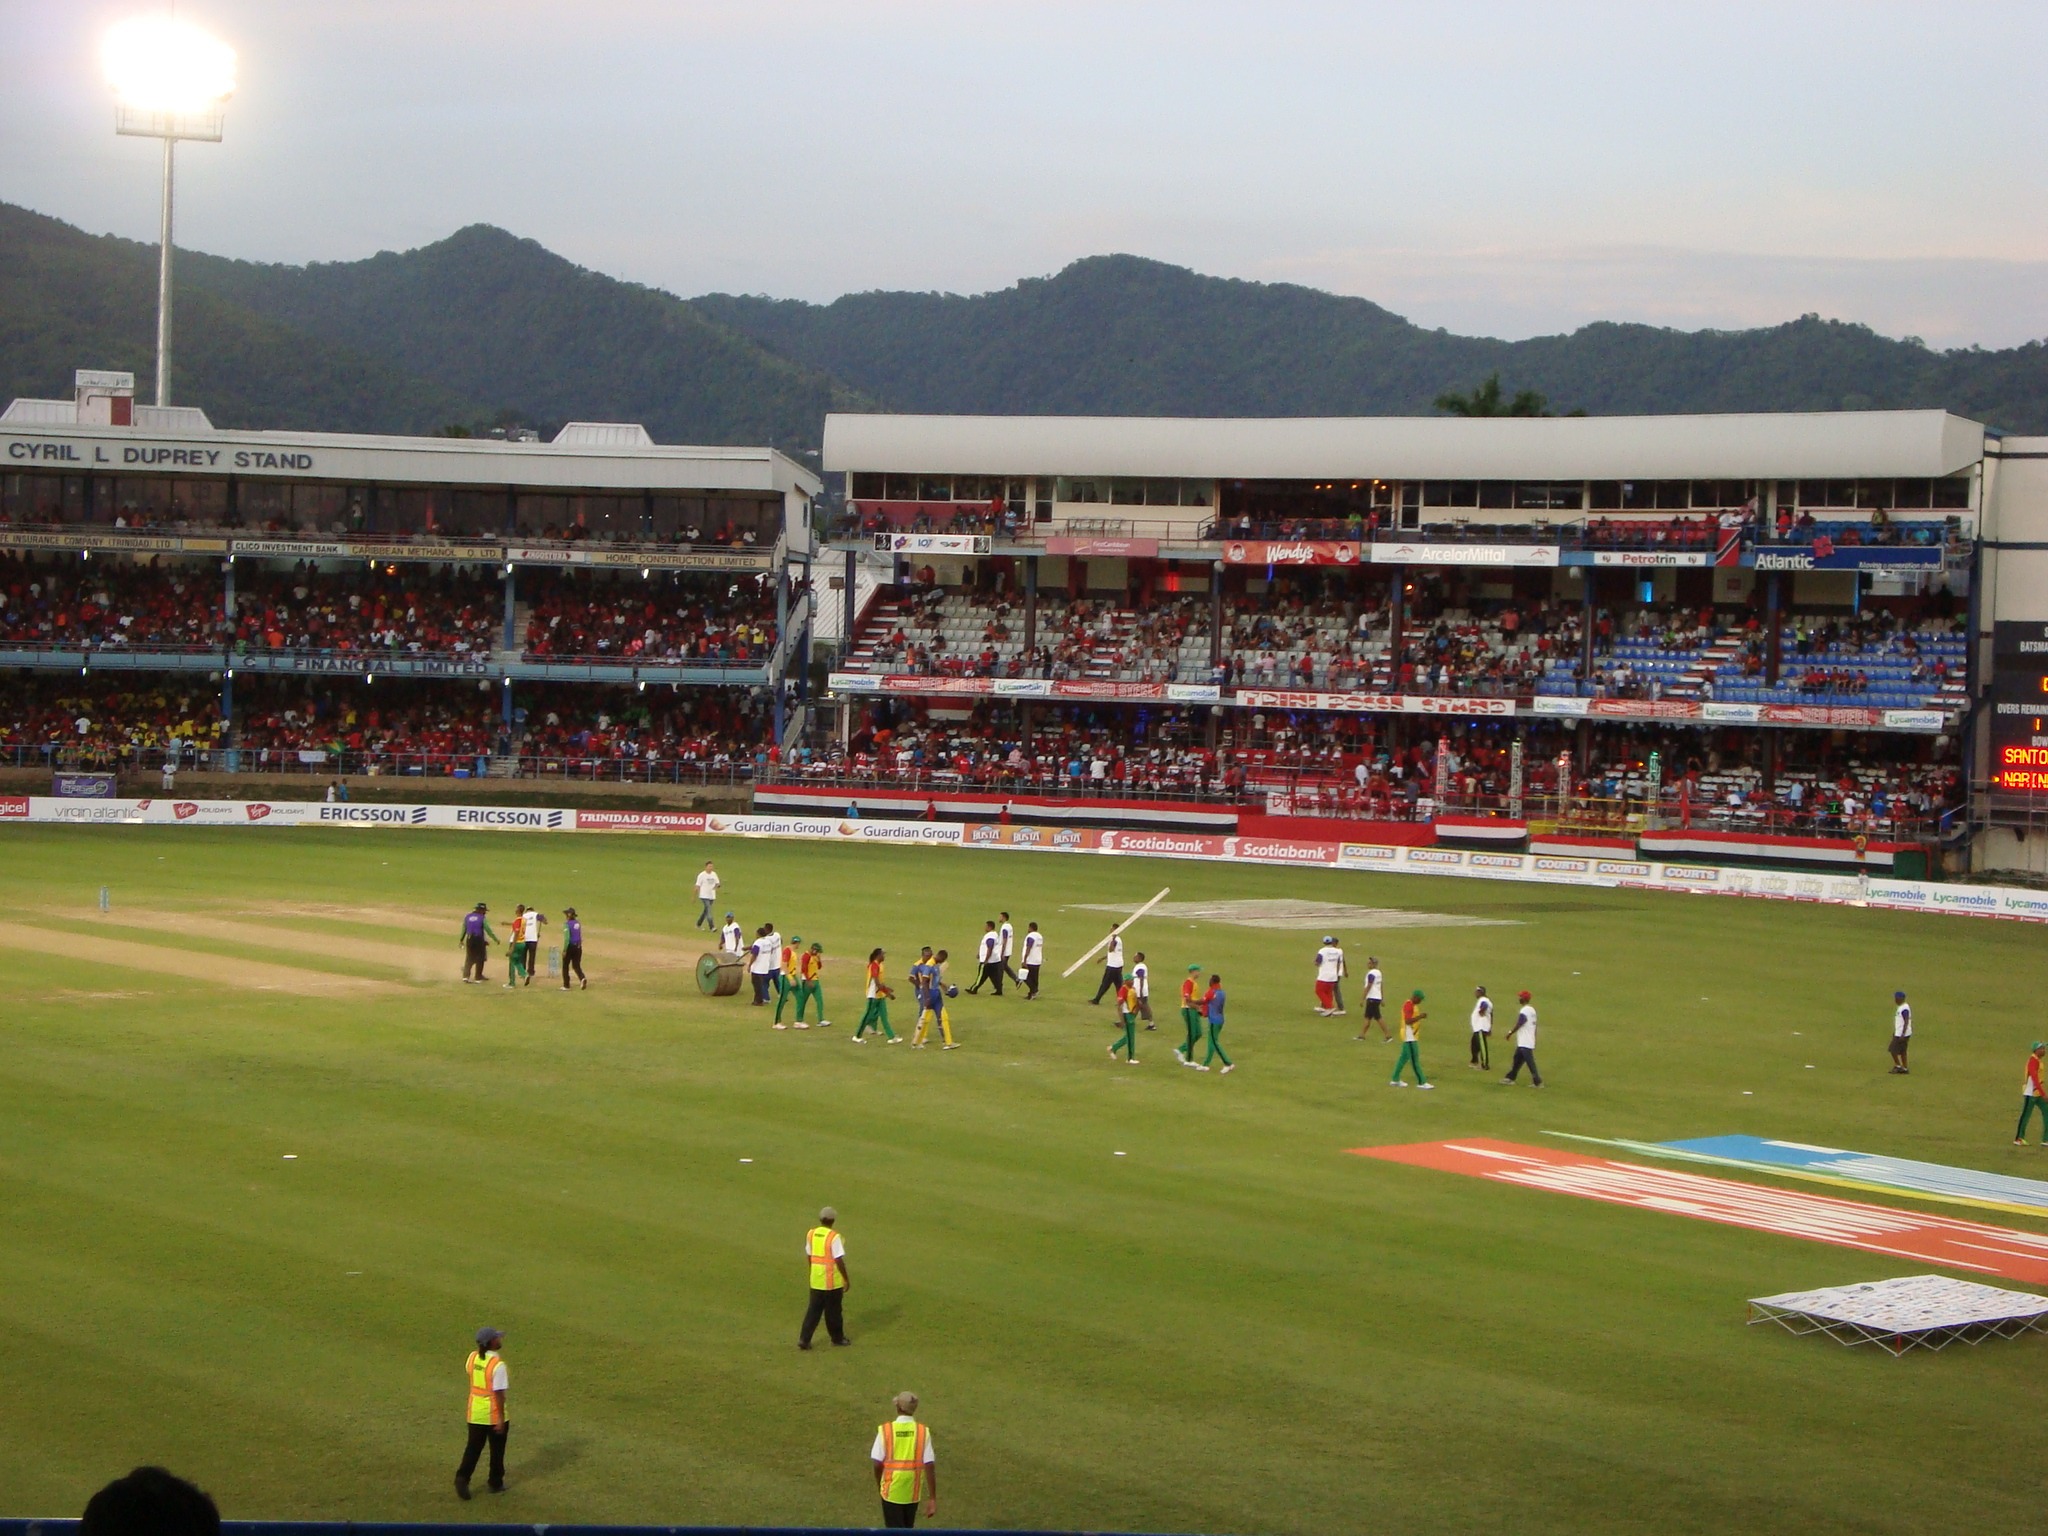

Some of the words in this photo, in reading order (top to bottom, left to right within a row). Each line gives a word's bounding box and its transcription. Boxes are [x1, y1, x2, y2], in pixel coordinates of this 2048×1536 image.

[8, 442, 80, 461] CYRIL
[95, 446, 109, 462] L
[123, 447, 220, 466] DUPREY
[235, 451, 313, 470] STAND
[13, 534, 60, 545] INSURANCE
[64, 536, 103, 547] COMPANY
[235, 542, 260, 551] CLICO
[262, 543, 314, 553] INVESTMENT
[315, 545, 338, 554] BANK
[352, 546, 404, 555] CARIBBEAN
[407, 546, 457, 557] METHANOL
[1266, 545, 1314, 563] Wendy's
[606, 553, 634, 563] HOME
[639, 554, 715, 565] CONSTRUCTION
[719, 556, 756, 567] LIMITED
[1421, 547, 1506, 563] ArcelorMittal
[1622, 554, 1677, 564] Petrotrin
[1756, 553, 1815, 570] Atlantic
[293, 659, 399, 672] FINANCAL
[410, 662, 488, 674] LIMITED
[1171, 688, 1218, 698] Lycamobile
[1243, 691, 1317, 708] TRINI
[1422, 698, 1507, 714] STAND
[1997, 703, 2020, 715] OVERS
[1705, 707, 1754, 718] Lycamobile
[1831, 708, 1871, 725] STEEL
[1888, 715, 1941, 725] Lycamobile
[55, 806, 92, 819] virgin
[94, 807, 140, 819] atlantic
[320, 807, 406, 822] ERICSSON
[456, 810, 542, 825] ERICSSON
[580, 813, 640, 823] TRINIDAD
[642, 814, 652, 824] &
[654, 815, 704, 826] TOBAGO
[734, 820, 790, 833] Guardian
[793, 822, 831, 836] Group
[863, 825, 920, 838] Guardian
[922, 827, 960, 842] Group
[972, 829, 1000, 841] BUSTA
[1012, 830, 1041, 842] BUSTA
[1053, 832, 1081, 844] BUSTA
[1120, 837, 1203, 853] Scotiabank
[1243, 843, 1327, 860] Scotiabank
[1346, 846, 1393, 858] COURTS
[1410, 850, 1459, 862] COURTS
[1471, 854, 1521, 867] COURTS
[1537, 858, 1586, 871] COURTS
[1599, 863, 1648, 875] COURTS
[1666, 867, 1717, 880] COURTS
[1866, 887, 1927, 901] Lycamobile
[1933, 892, 1997, 906] Lycamobile
